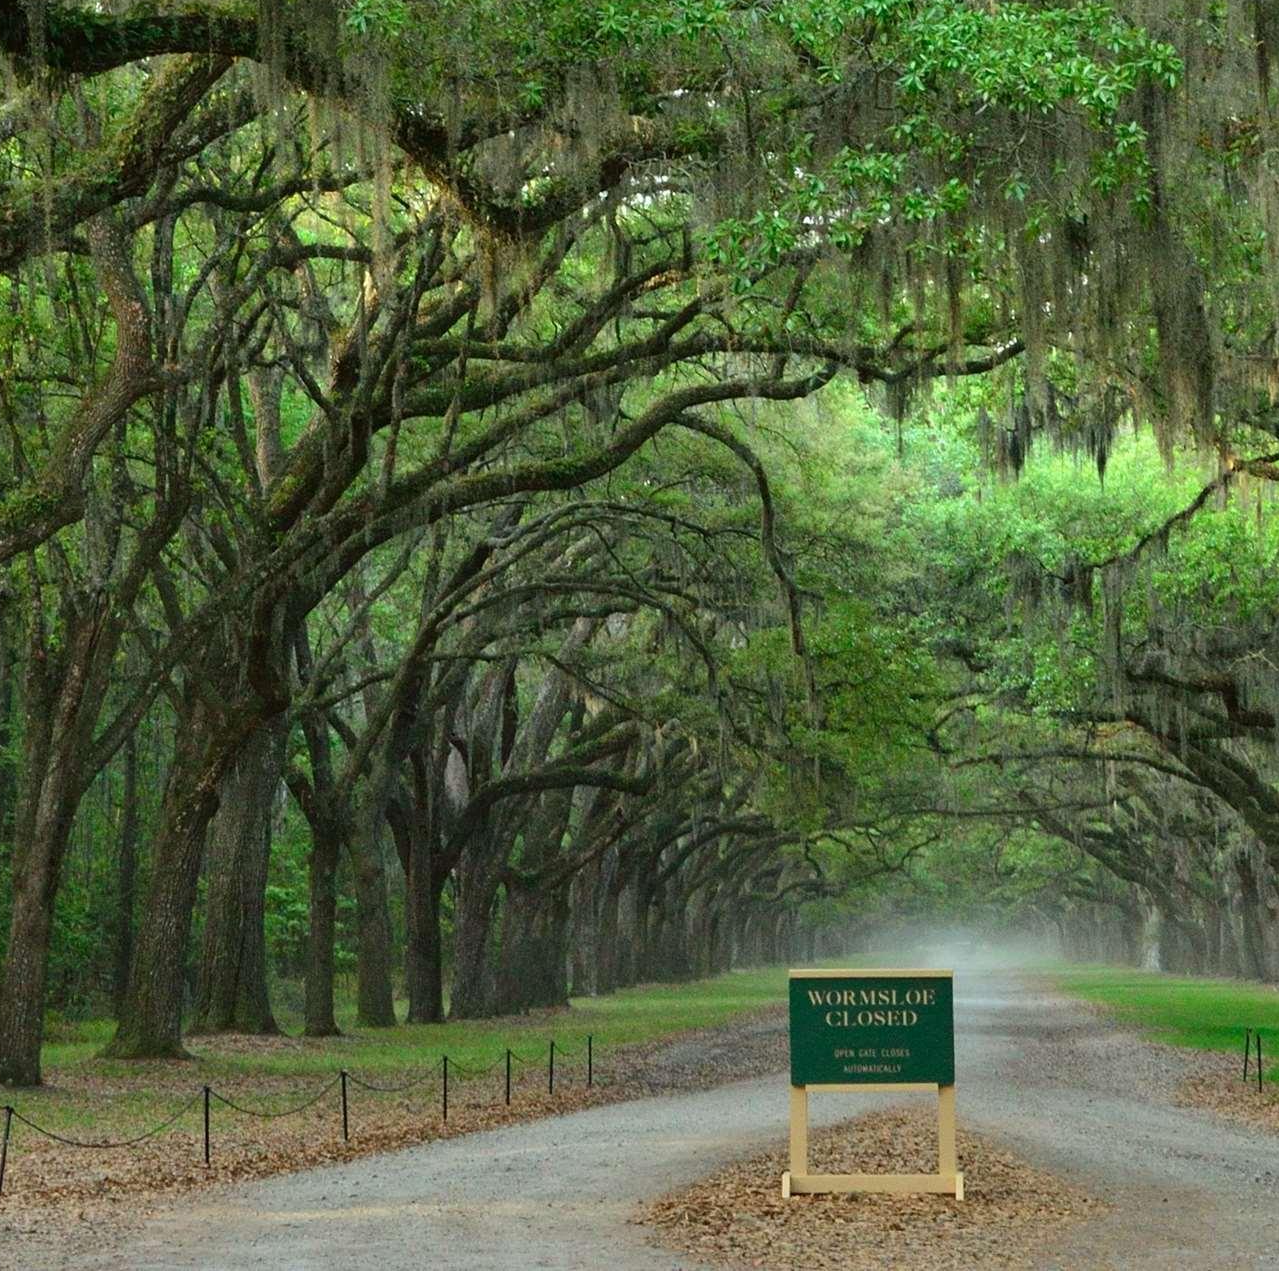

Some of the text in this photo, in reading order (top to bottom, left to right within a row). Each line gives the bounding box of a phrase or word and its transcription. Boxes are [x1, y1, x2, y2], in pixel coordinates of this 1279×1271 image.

[807, 989, 936, 1006] WORMSLOE
[825, 1011, 918, 1027] CLOSED
[834, 1048, 911, 1058] OPEN GATE CLOSES
[843, 1063, 902, 1073] AUTOMATICALLY
